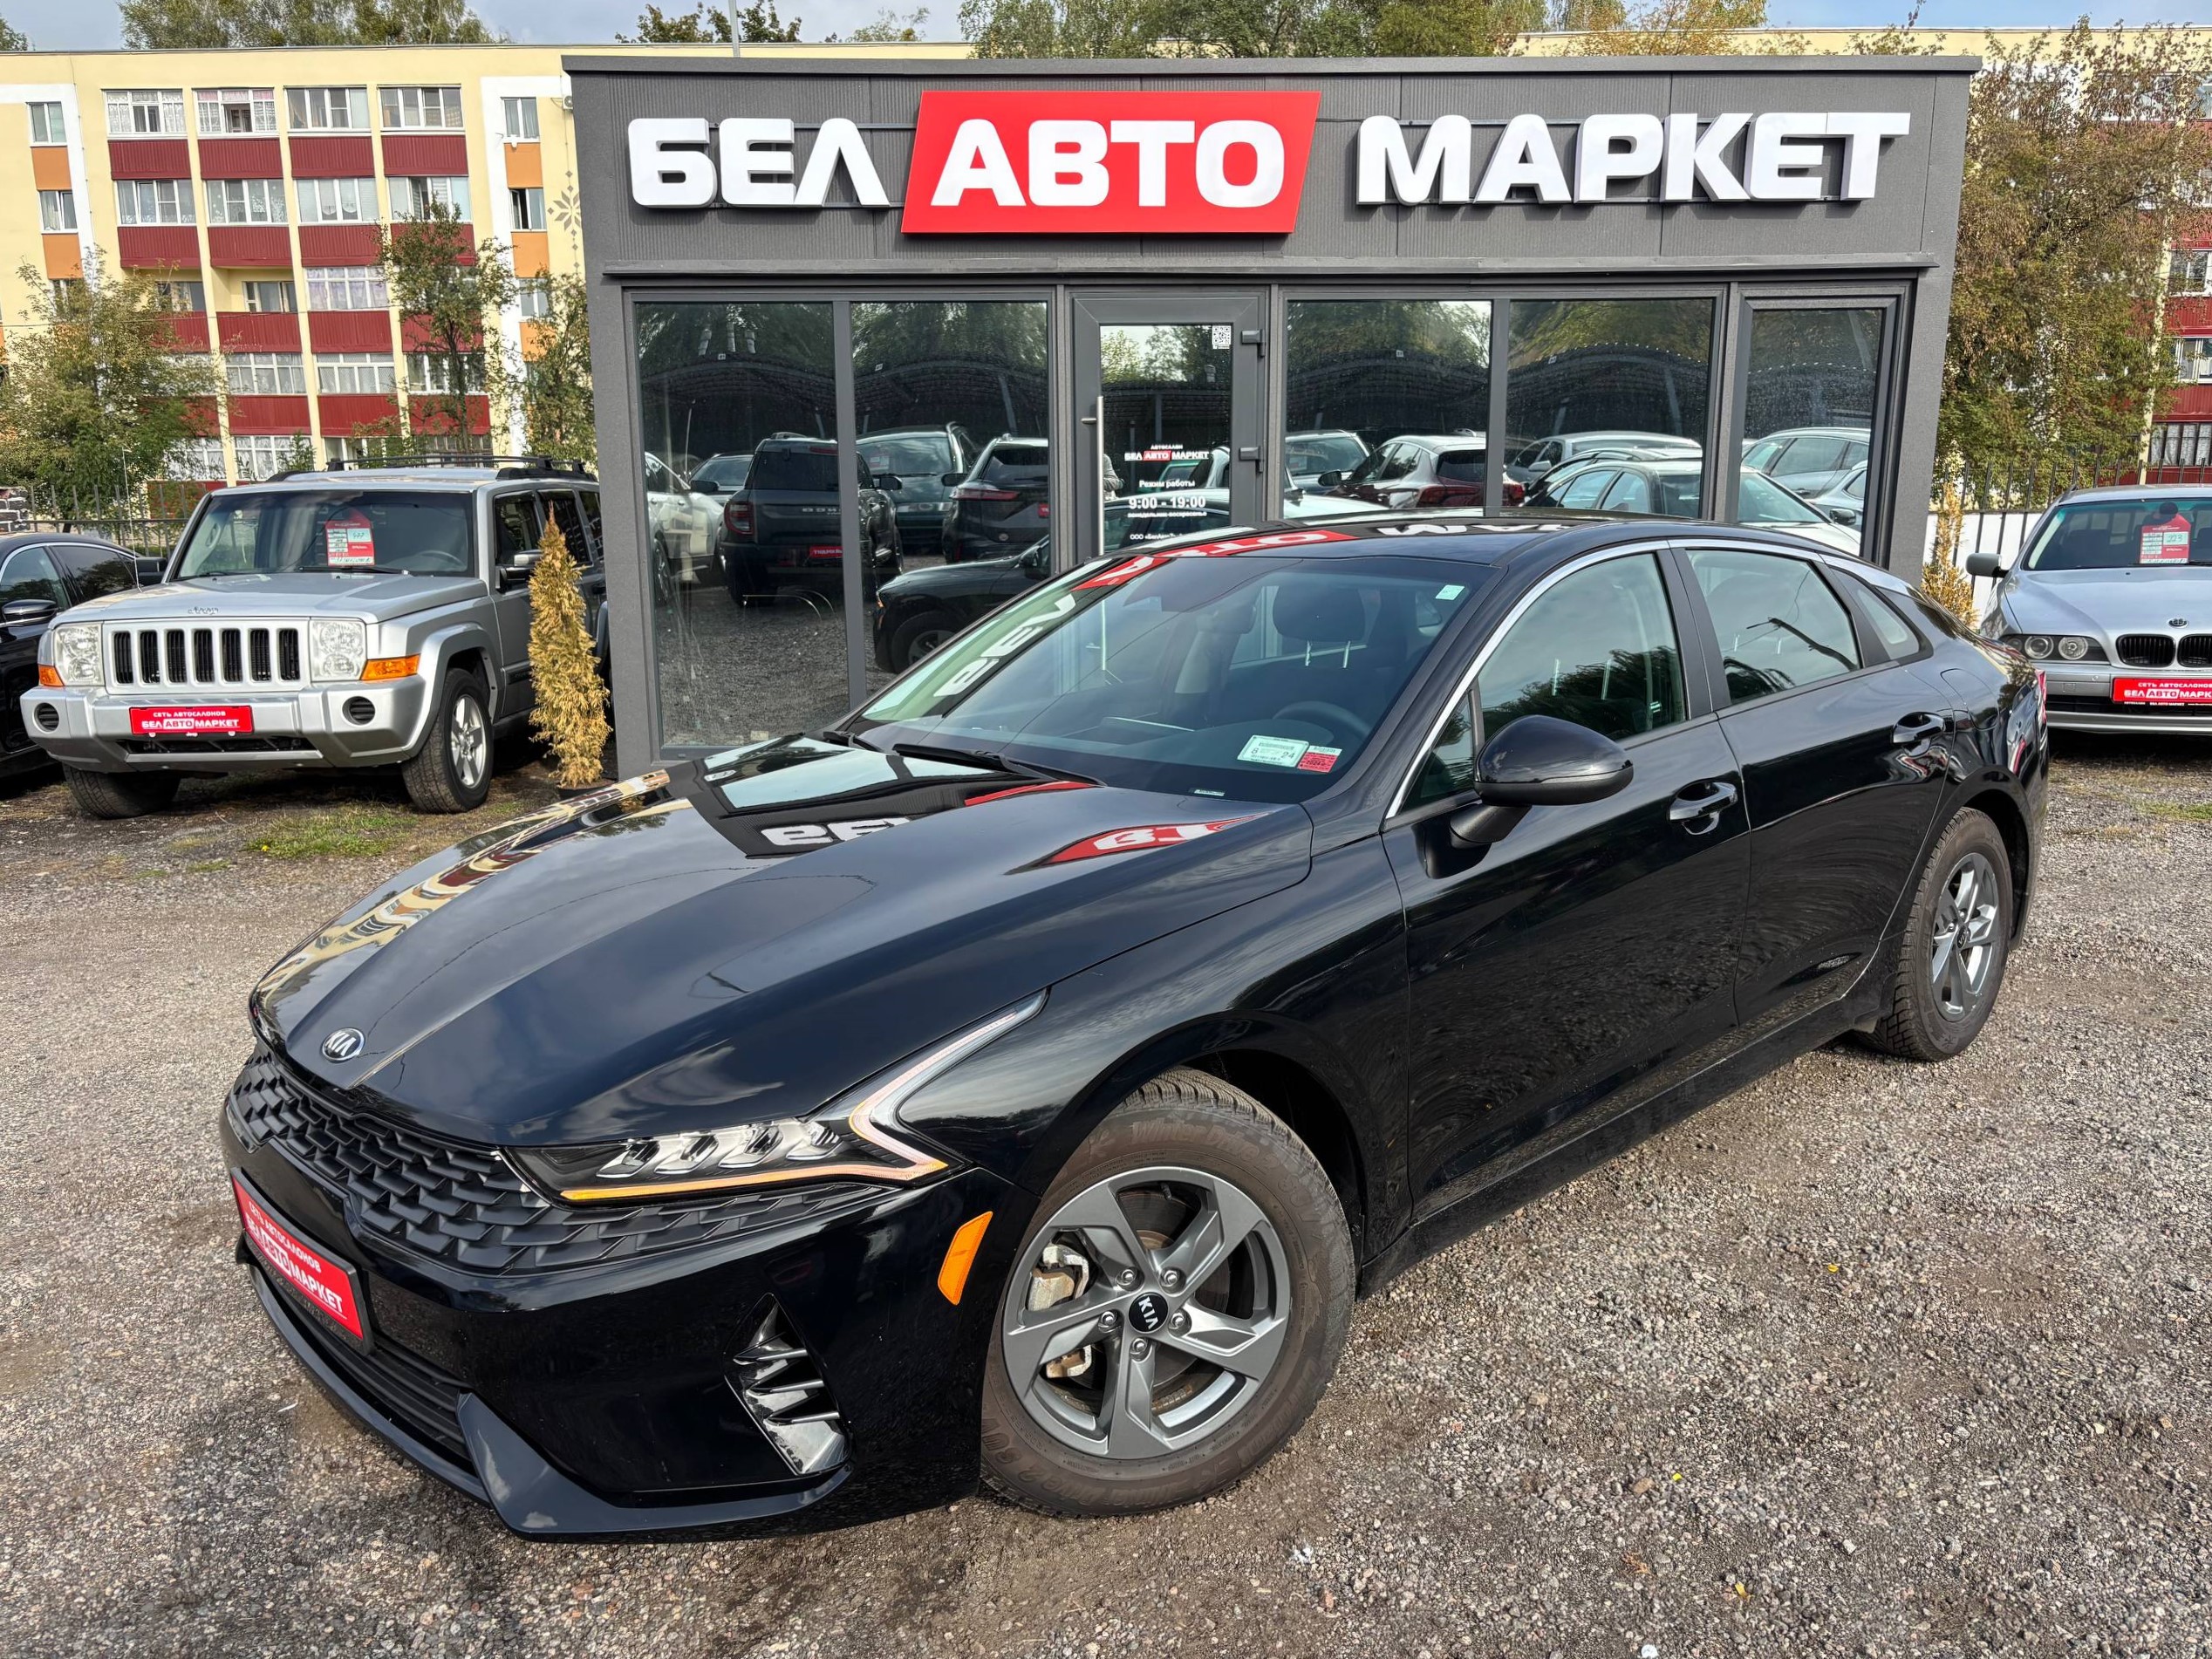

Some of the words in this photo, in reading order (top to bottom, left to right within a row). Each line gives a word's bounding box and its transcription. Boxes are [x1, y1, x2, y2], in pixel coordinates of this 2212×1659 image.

[628, 116, 890, 208] БЕЛ
[930, 119, 1286, 208] АВТО
[1356, 112, 1911, 207] МАРКЕТ
[1124, 452, 1143, 461] БЕЛ
[1171, 451, 1209, 460] МАРКЕТ
[1166, 479, 1196, 488] работы
[1129, 497, 1157, 509] 9:00
[1170, 495, 1205, 508] 19:00
[290, 1261, 343, 1313] МАРКЕТ
[1138, 1296, 1158, 1329] KIA
